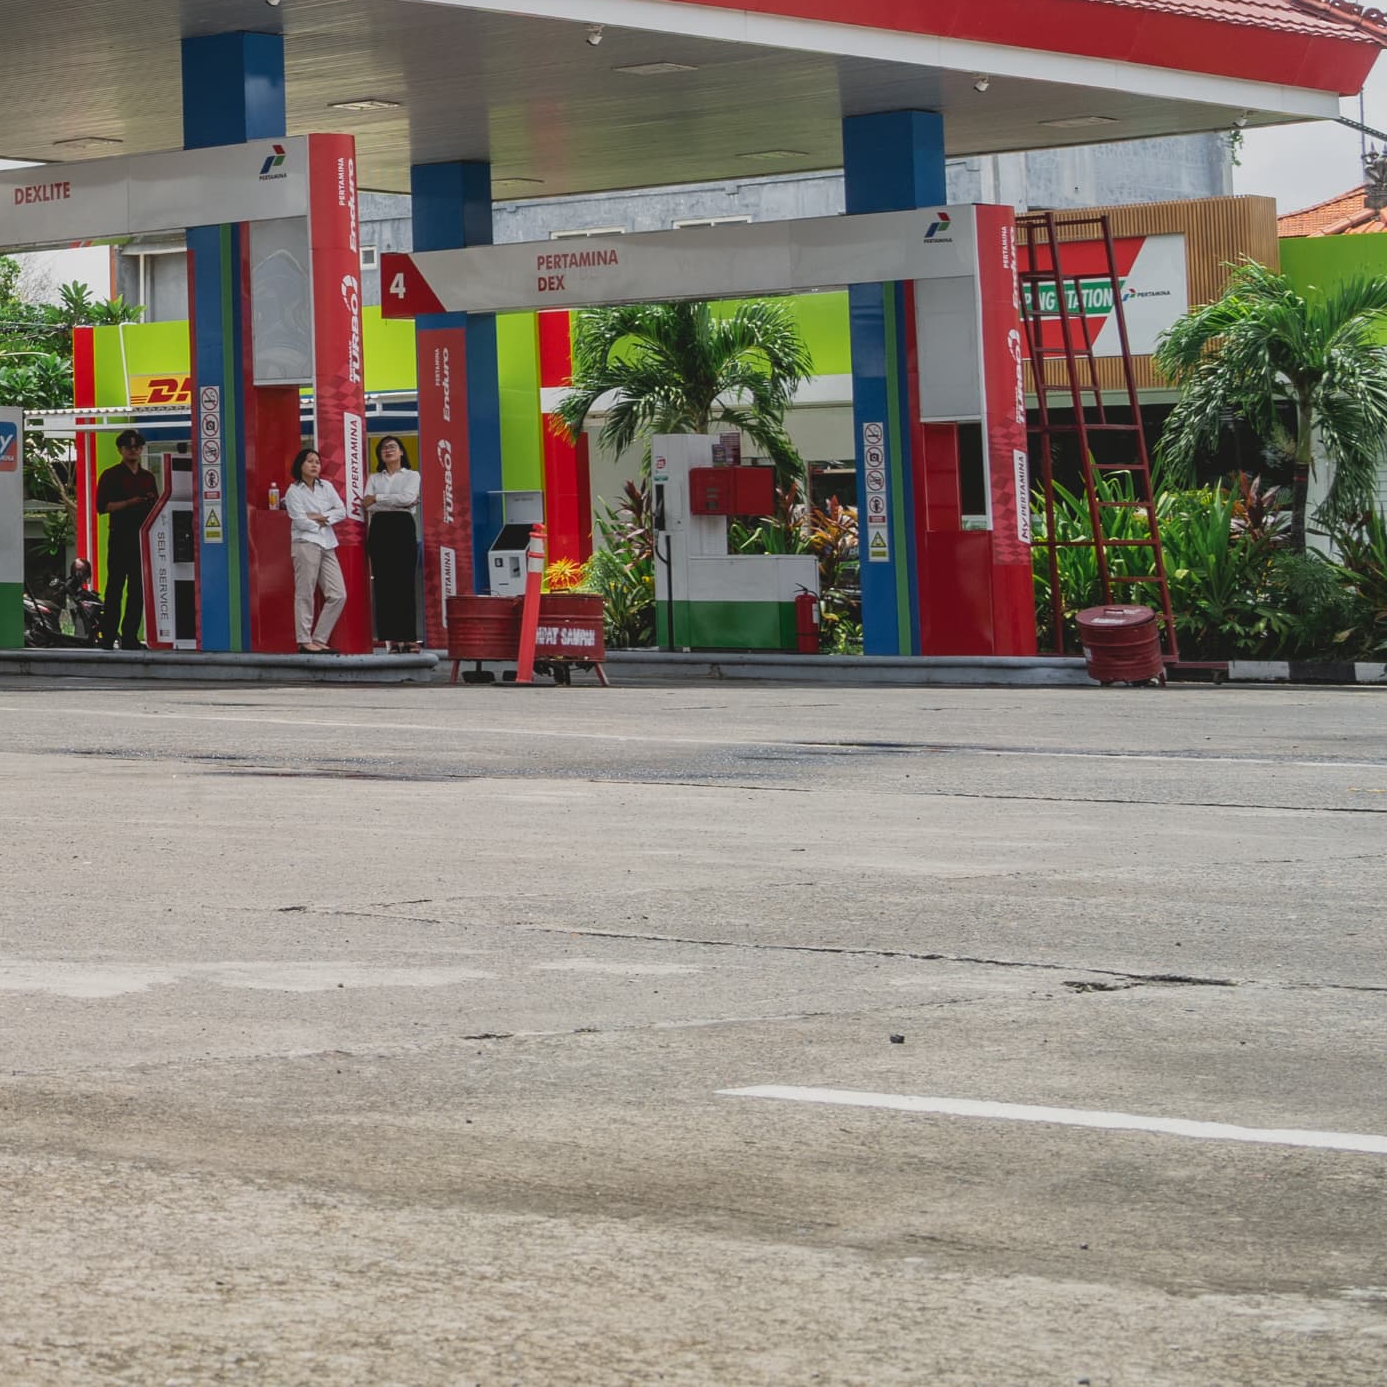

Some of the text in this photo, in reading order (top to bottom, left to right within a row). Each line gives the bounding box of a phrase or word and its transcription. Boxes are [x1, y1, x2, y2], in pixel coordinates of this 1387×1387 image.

[14, 181, 71, 205] DEXLITE
[338, 157, 347, 206] PERTAMINA
[537, 249, 619, 271] PERTAMINA
[389, 273, 406, 299] 4
[537, 275, 565, 292] DEX
[157, 532, 167, 562] SELF
[158, 568, 170, 621] SERVICE
